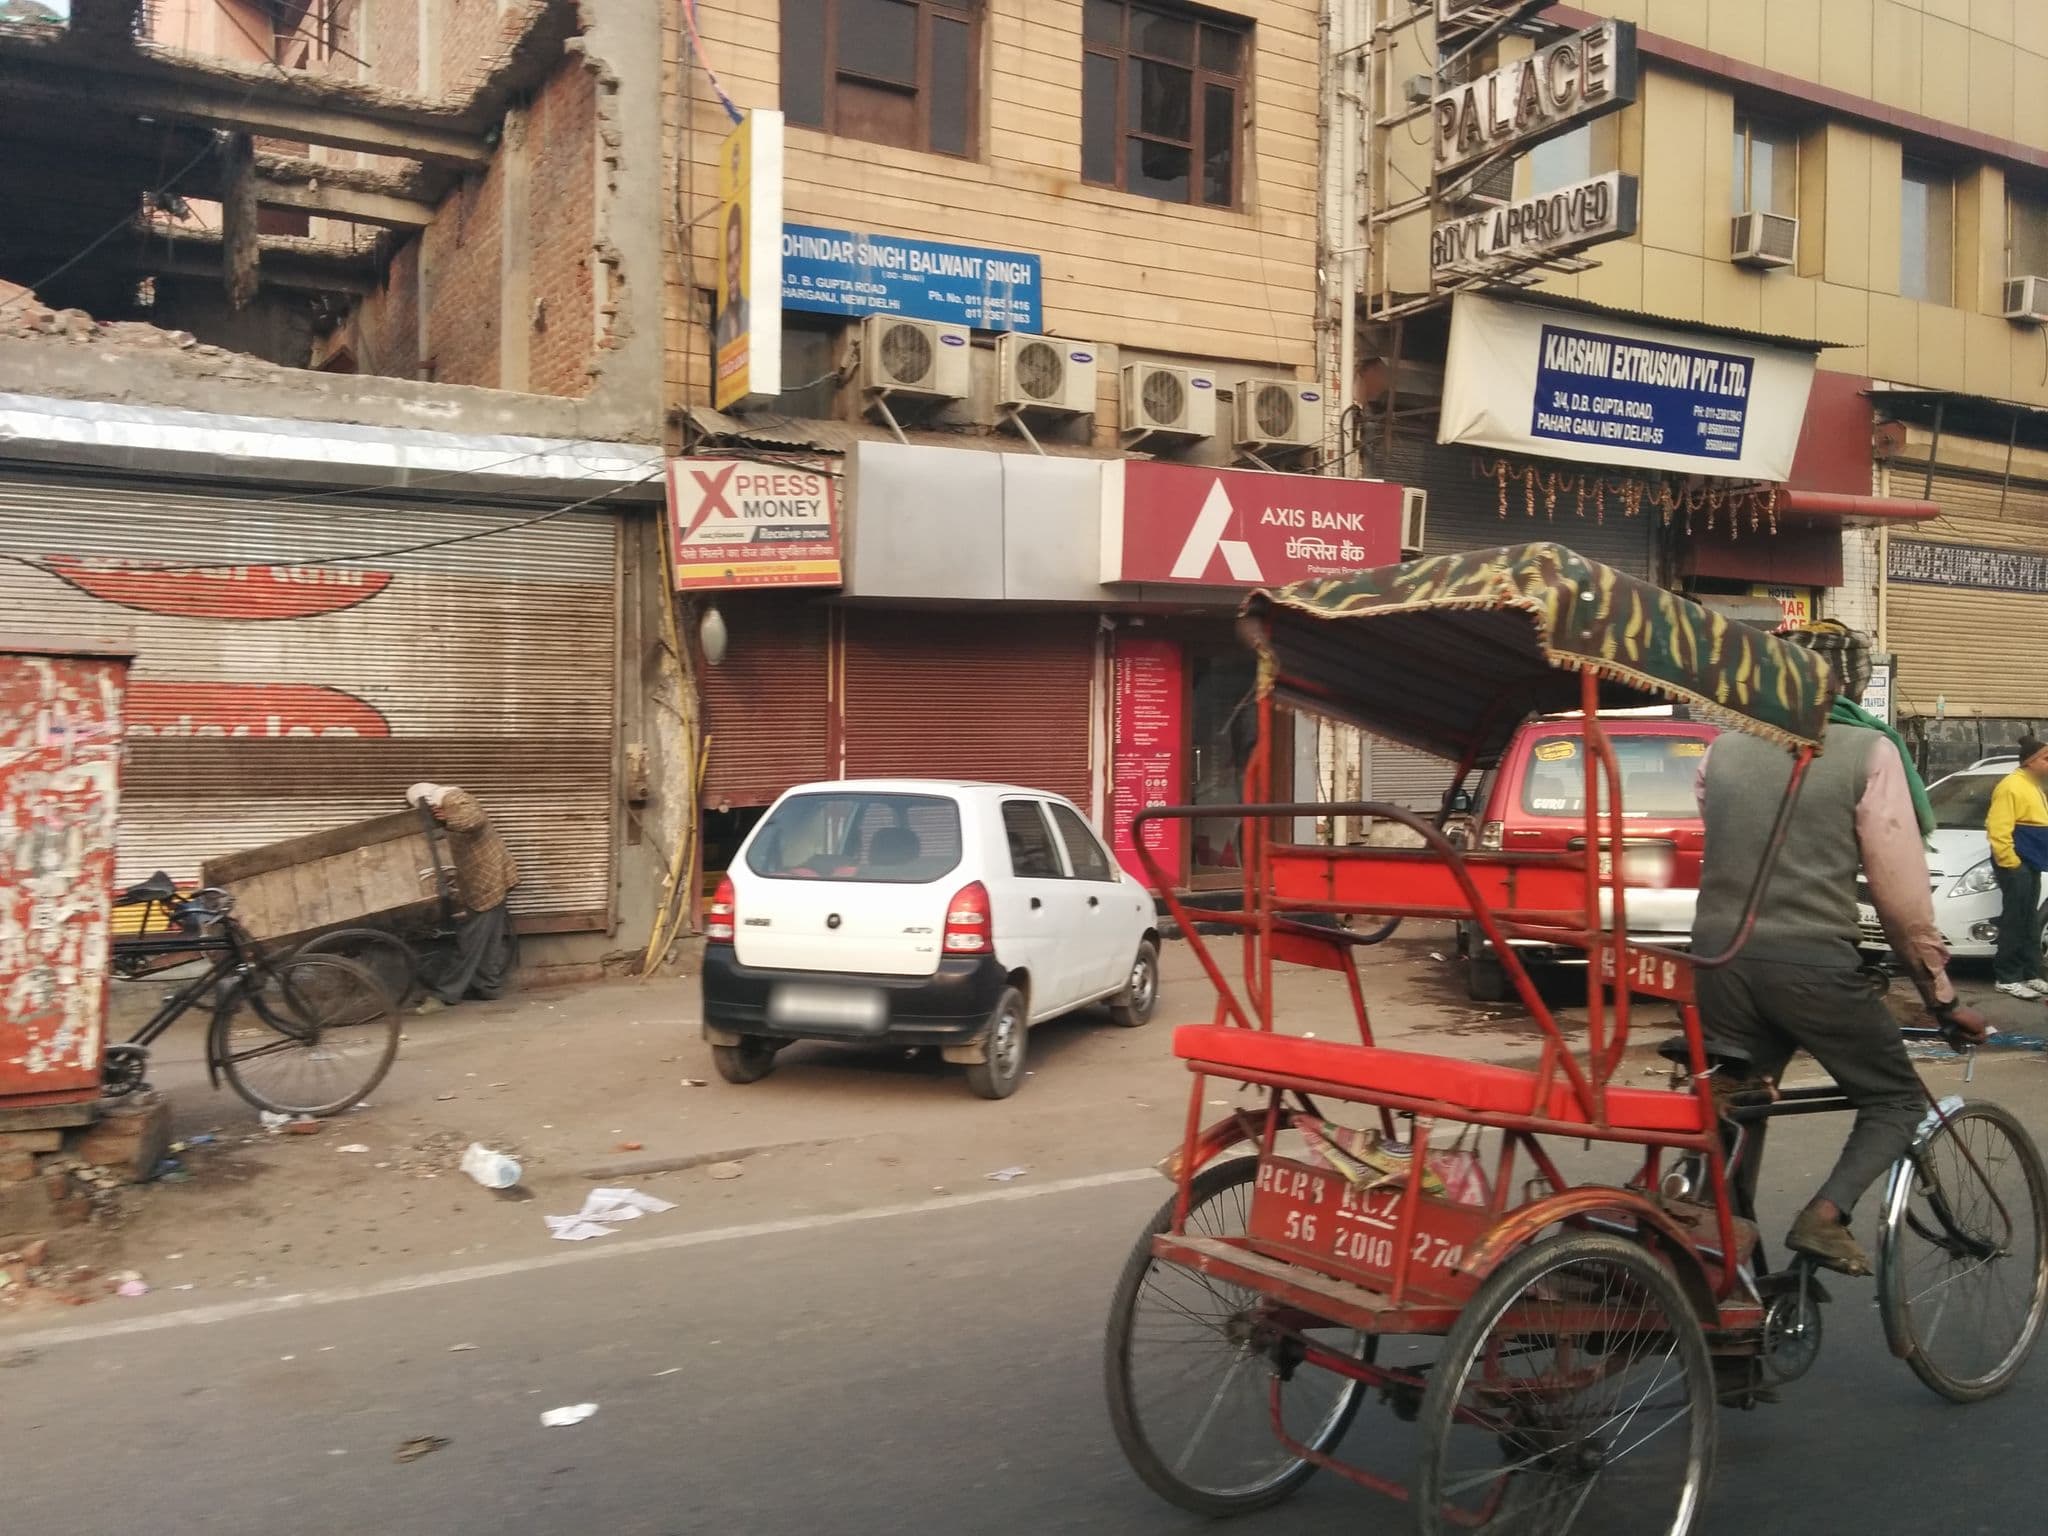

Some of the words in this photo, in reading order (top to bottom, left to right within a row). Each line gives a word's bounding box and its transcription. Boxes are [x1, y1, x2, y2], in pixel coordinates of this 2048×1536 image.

[1436, 27, 1608, 160] PALACE
[1493, 181, 1608, 250] APPROVED
[858, 243, 907, 270] SINGH
[910, 250, 983, 279] BALWANT
[985, 260, 1031, 285] SINGH
[816, 277, 853, 291] GUPTA
[854, 281, 888, 295] ROAD
[841, 293, 867, 305] NEW
[868, 296, 900, 309] DELHI
[1544, 334, 1611, 377] KARSHNI
[1612, 345, 1690, 389] EXTRUSION
[1691, 357, 1718, 393] PVT.
[1720, 362, 1746, 397] LTD.
[1571, 393, 1590, 412] D.B.
[1592, 397, 1626, 418] GUPTA
[1626, 401, 1654, 422] ROAD,
[1537, 413, 1571, 435] PAHAR
[1573, 417, 1600, 438] GANJ
[1601, 422, 1624, 440] NEW
[1623, 424, 1664, 444] DELHI-55
[743, 500, 821, 518] MONEY
[1260, 507, 1305, 528] AXIS
[1311, 510, 1365, 532] BANK
[1285, 536, 1338, 560] ऐक्सिस
[1340, 540, 1365, 562] बैंक
[1932, 546, 2018, 588] EQUIPMENTS
[1767, 587, 1797, 599] HOTEL
[1284, 1210, 1318, 1242] 56
[1333, 1227, 1394, 1268] 2010
